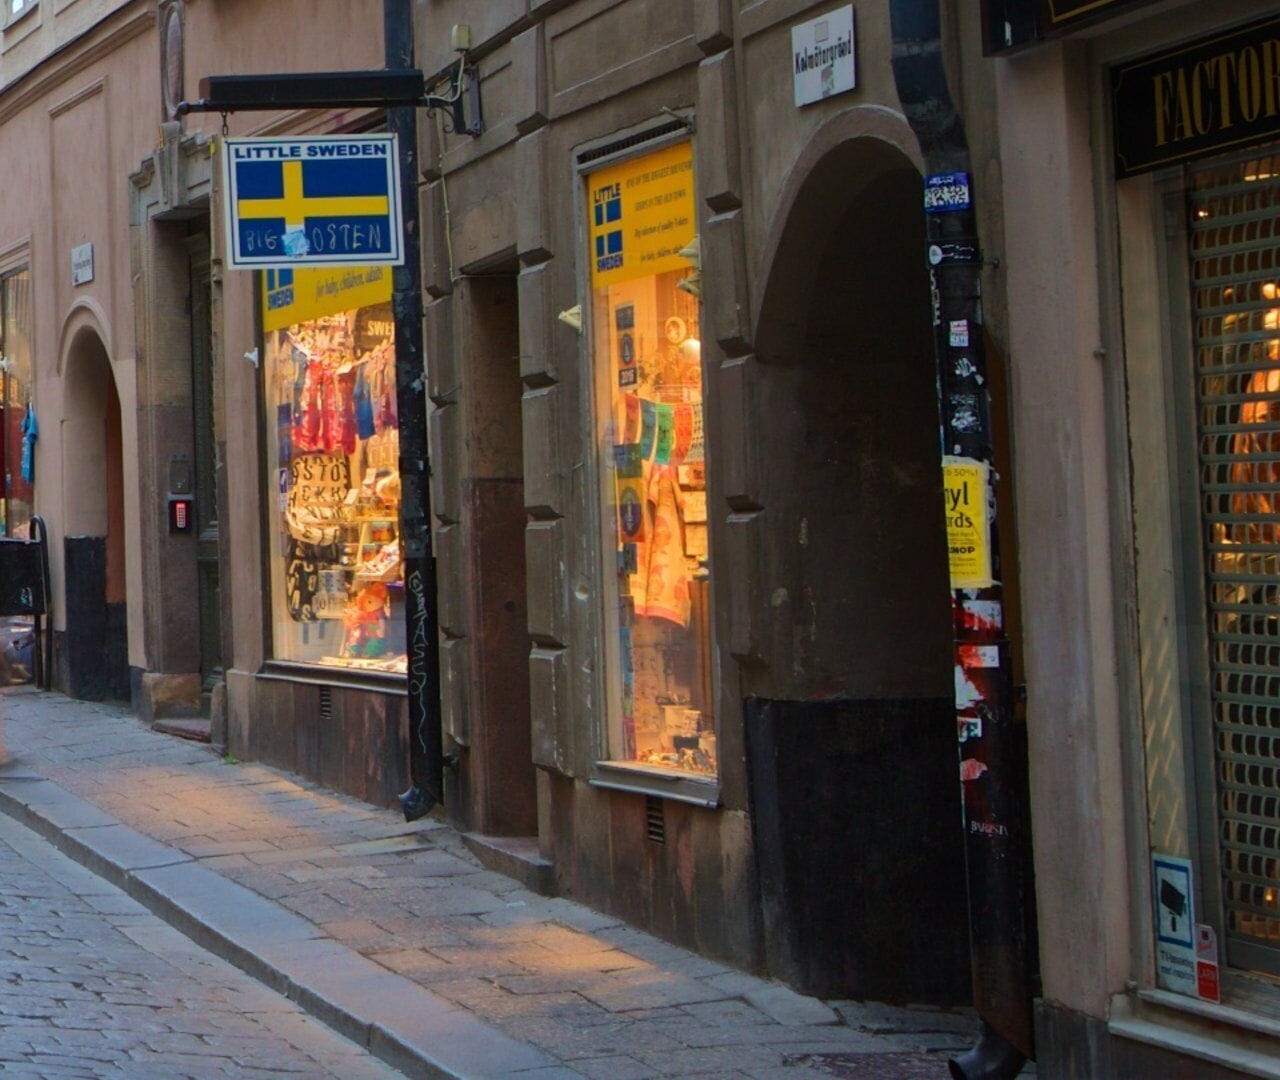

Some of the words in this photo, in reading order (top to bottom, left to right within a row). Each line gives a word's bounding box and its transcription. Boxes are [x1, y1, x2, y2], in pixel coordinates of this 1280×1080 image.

[234, 145, 301, 159] LITTLE
[307, 144, 387, 158] SWEDEN
[593, 182, 621, 203] LITTLE
